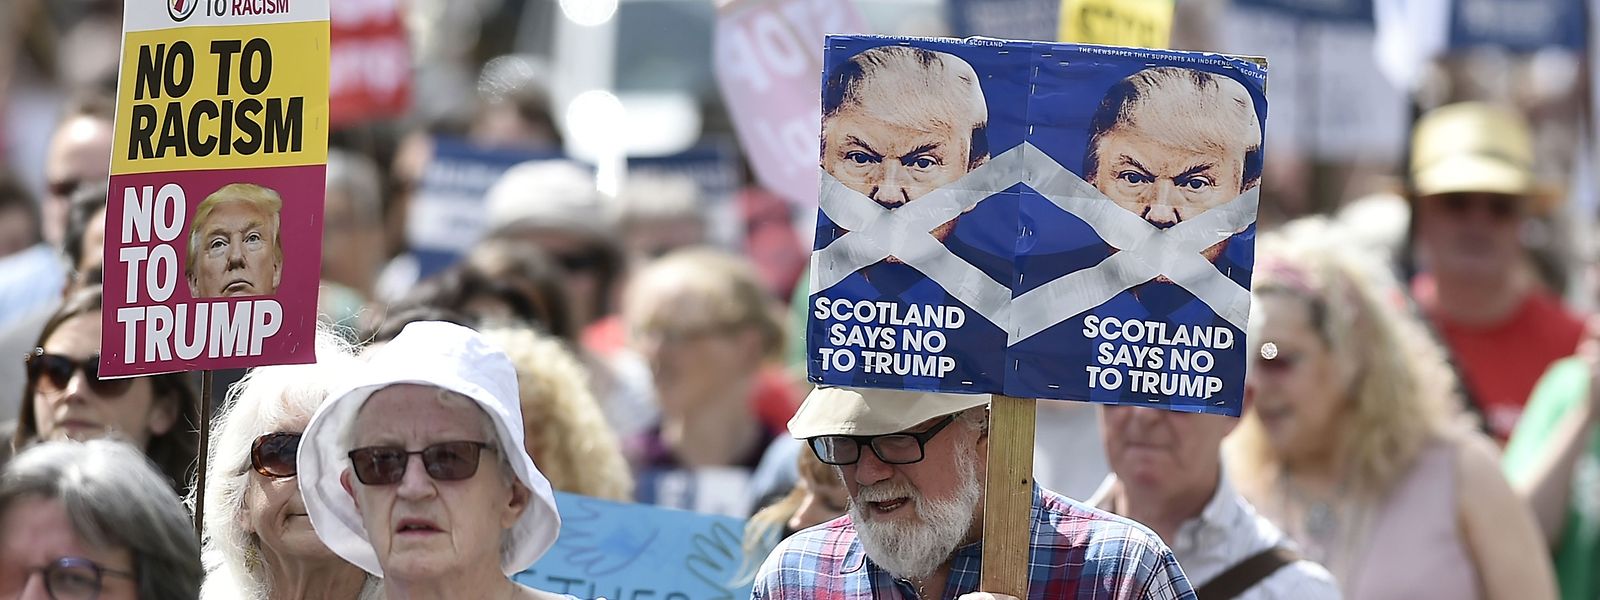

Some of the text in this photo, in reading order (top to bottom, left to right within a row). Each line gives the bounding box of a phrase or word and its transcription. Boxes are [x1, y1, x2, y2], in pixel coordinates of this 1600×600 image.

[231, 0, 290, 16] RACISM
[968, 39, 1004, 47] SCOTLAND
[1092, 48, 1132, 58] NEWSPAPER
[1134, 51, 1150, 59] THAT
[1151, 53, 1186, 63] SUPPORTS
[134, 40, 194, 101] NO
[209, 37, 273, 96] TO
[127, 96, 304, 161] RACISM
[121, 183, 187, 244] NO
[119, 243, 179, 304] TO
[814, 296, 966, 329] SCOTLAND
[117, 299, 284, 364] TRUMP
[830, 323, 947, 354] SAYS NO
[1082, 314, 1234, 350] SCOTLAND
[818, 347, 956, 378] TO TRUMP
[1097, 342, 1215, 374] SAYS NO
[1085, 365, 1224, 399] TO TRUMP
